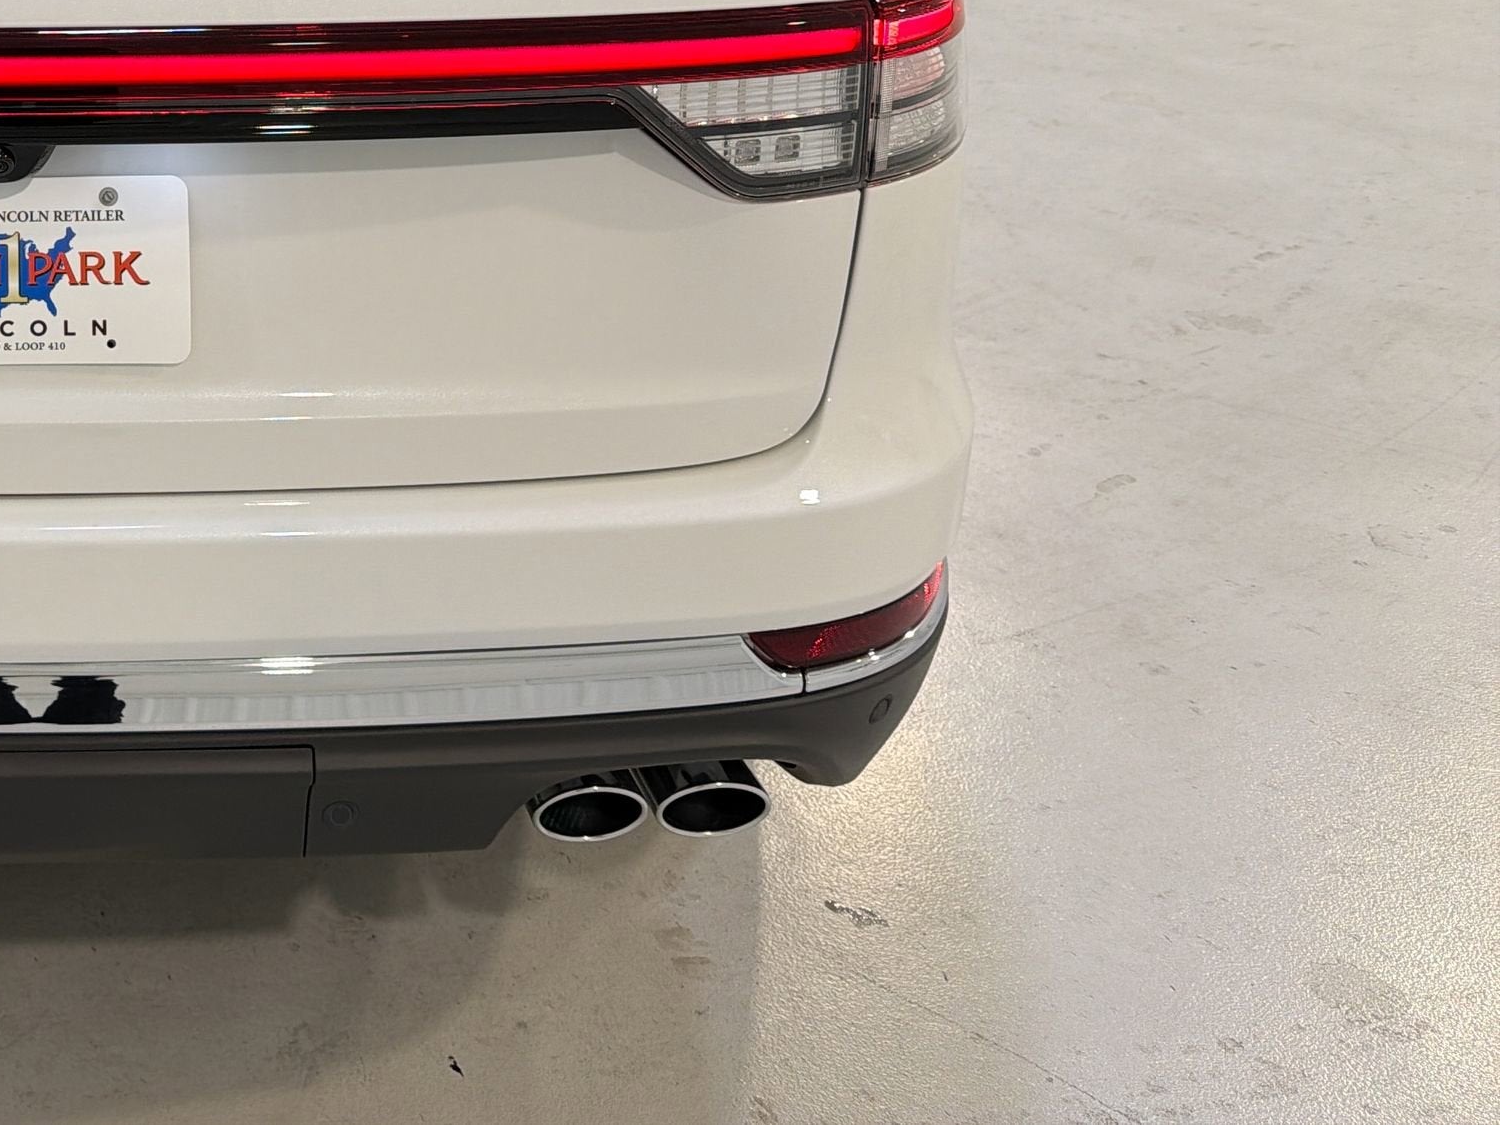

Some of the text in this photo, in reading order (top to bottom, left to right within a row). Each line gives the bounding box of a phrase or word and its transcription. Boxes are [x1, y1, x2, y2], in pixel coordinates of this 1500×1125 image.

[53, 209, 125, 222] RETAILER
[27, 250, 151, 287] PARK
[3, 342, 13, 351] &
[15, 341, 46, 352] LOOP
[48, 341, 67, 351] 410
